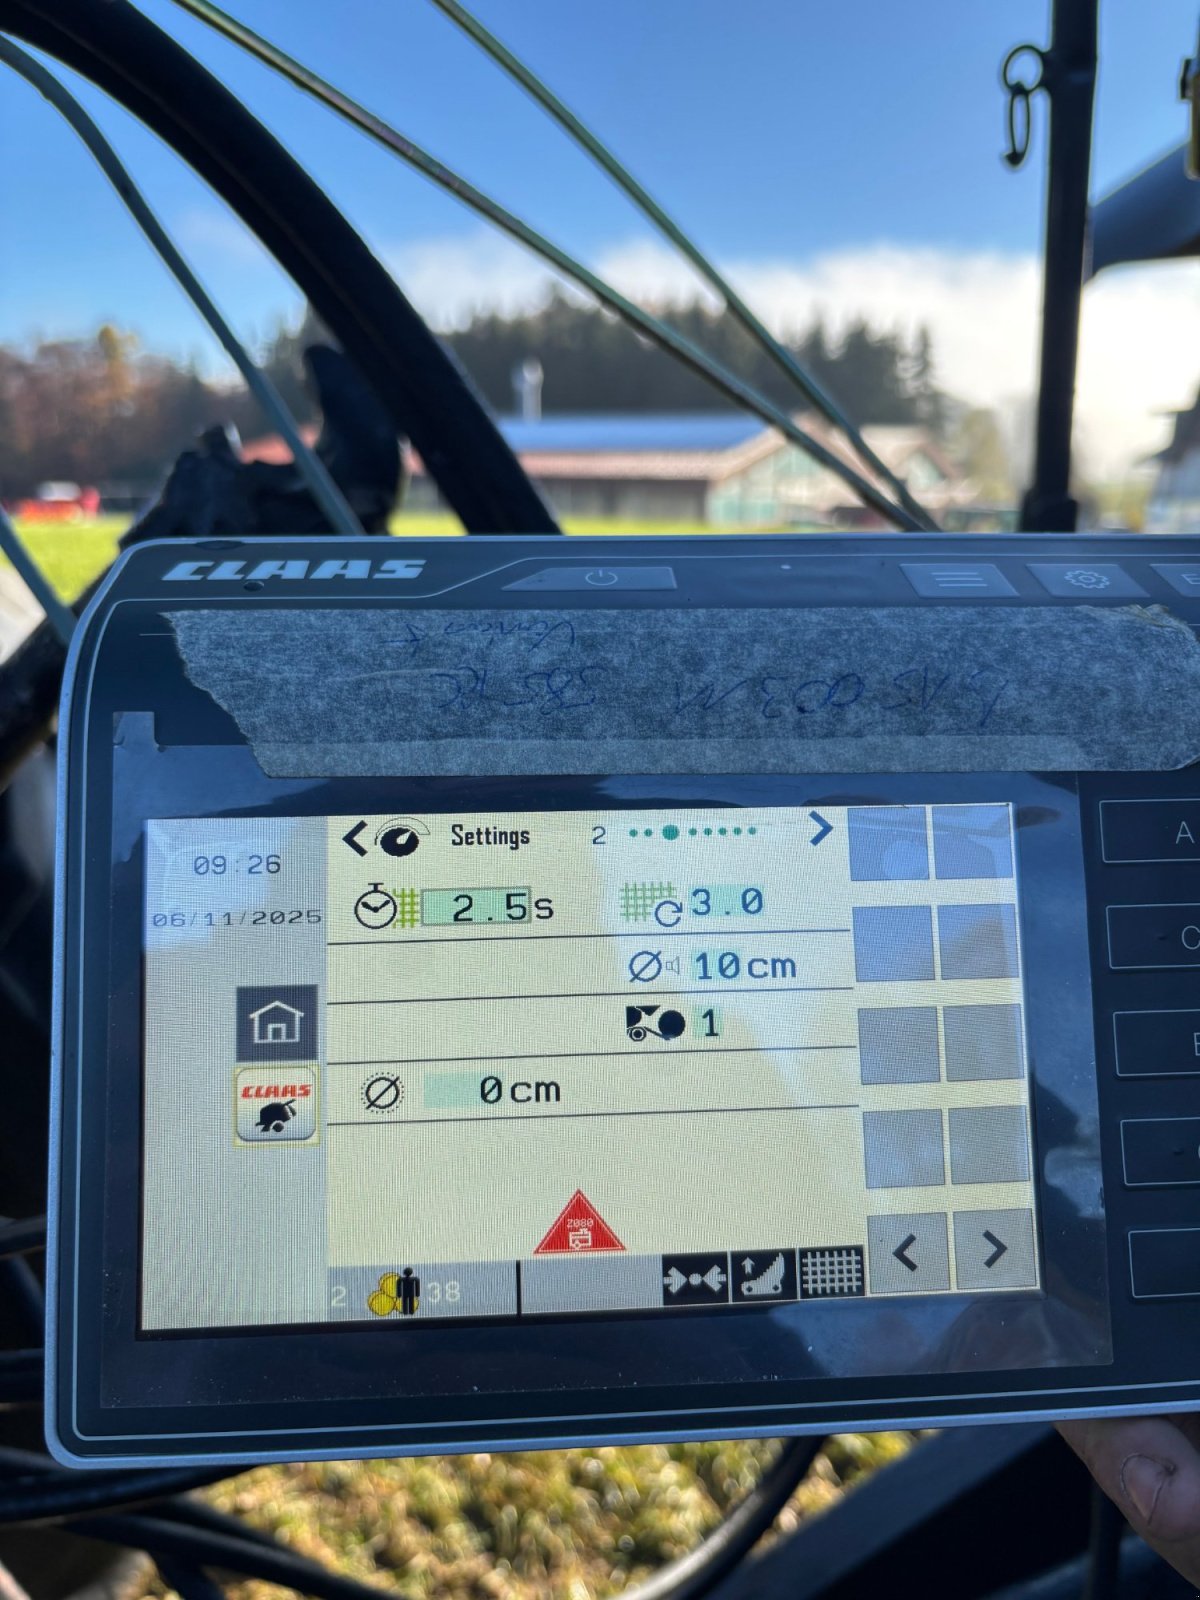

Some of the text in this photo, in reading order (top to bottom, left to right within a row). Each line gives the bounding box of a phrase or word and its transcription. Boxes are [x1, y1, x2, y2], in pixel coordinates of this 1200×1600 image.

[162, 560, 426, 581] CLAAS
[451, 823, 530, 849] Settings
[591, 825, 606, 845] 2
[1175, 820, 1196, 844] A
[193, 854, 282, 876] 09:26
[691, 887, 764, 916] 3.0
[152, 908, 323, 928] 06/11/2025
[701, 1008, 720, 1037] 1
[241, 1084, 313, 1099] CLAAS
[427, 1281, 461, 1303] 38
